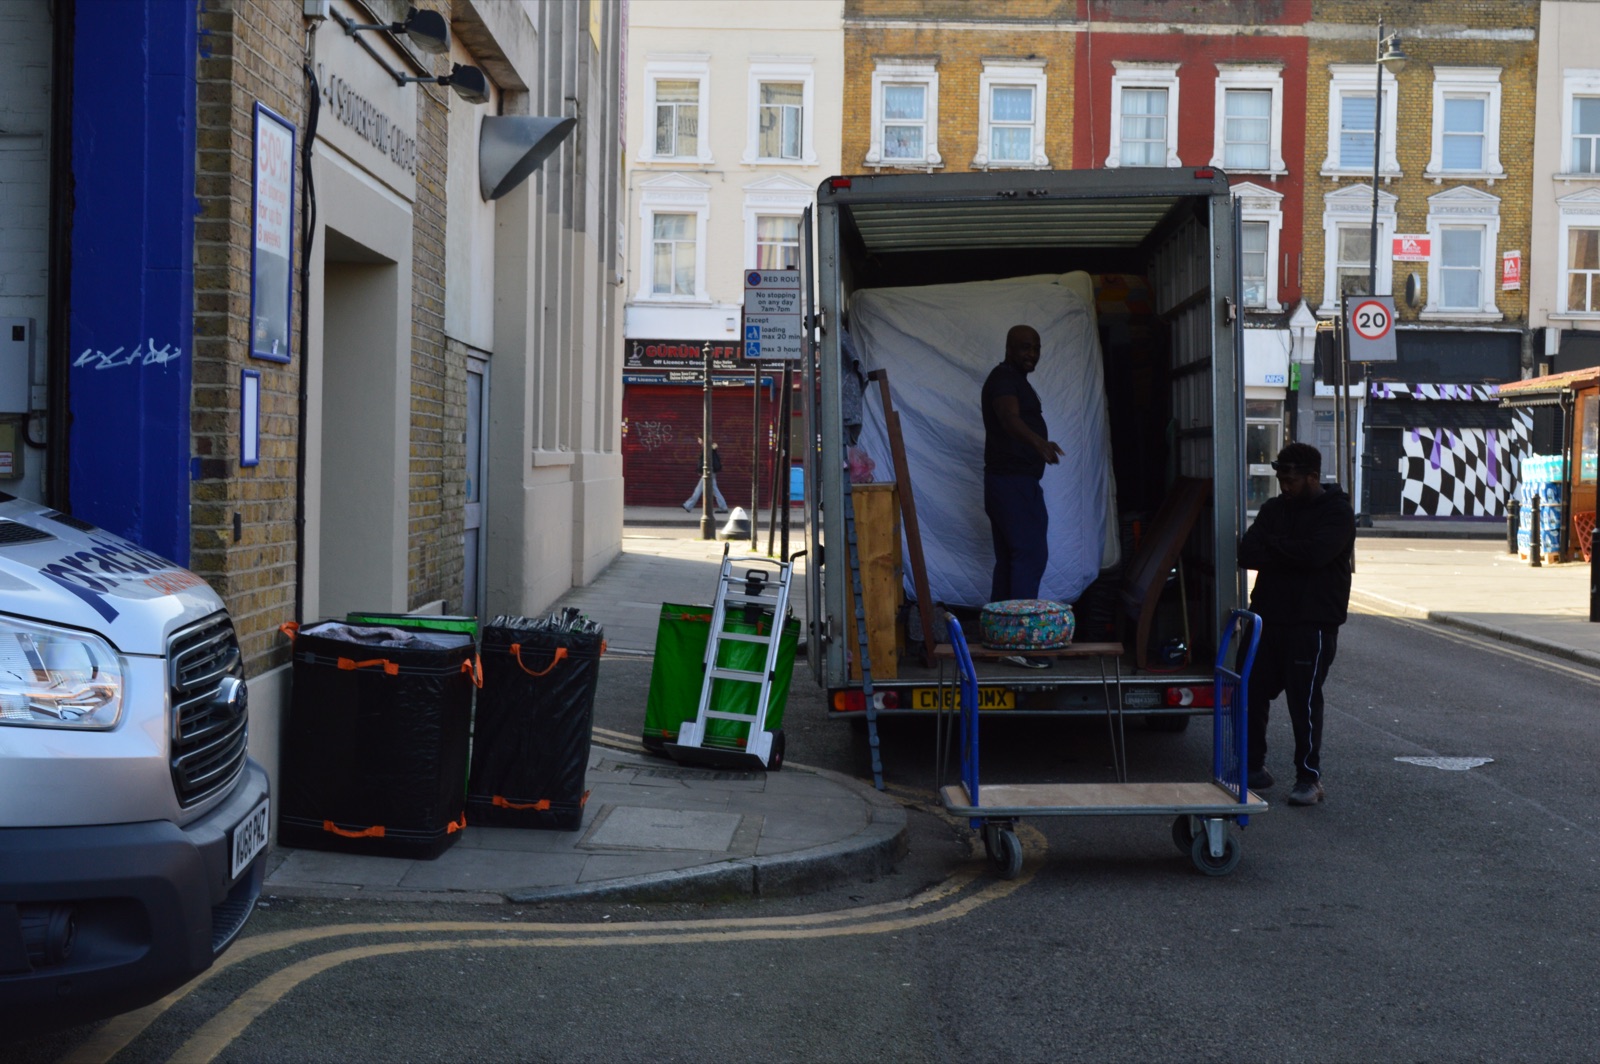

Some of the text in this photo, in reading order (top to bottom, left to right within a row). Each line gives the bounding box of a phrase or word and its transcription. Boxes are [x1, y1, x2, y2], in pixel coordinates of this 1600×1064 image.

[259, 127, 288, 184] 50%
[258, 200, 268, 219] for
[1359, 313, 1385, 328] 20
[646, 344, 699, 358] GÜRÜN
[710, 345, 734, 359] FF
[1265, 375, 1284, 383] NHS
